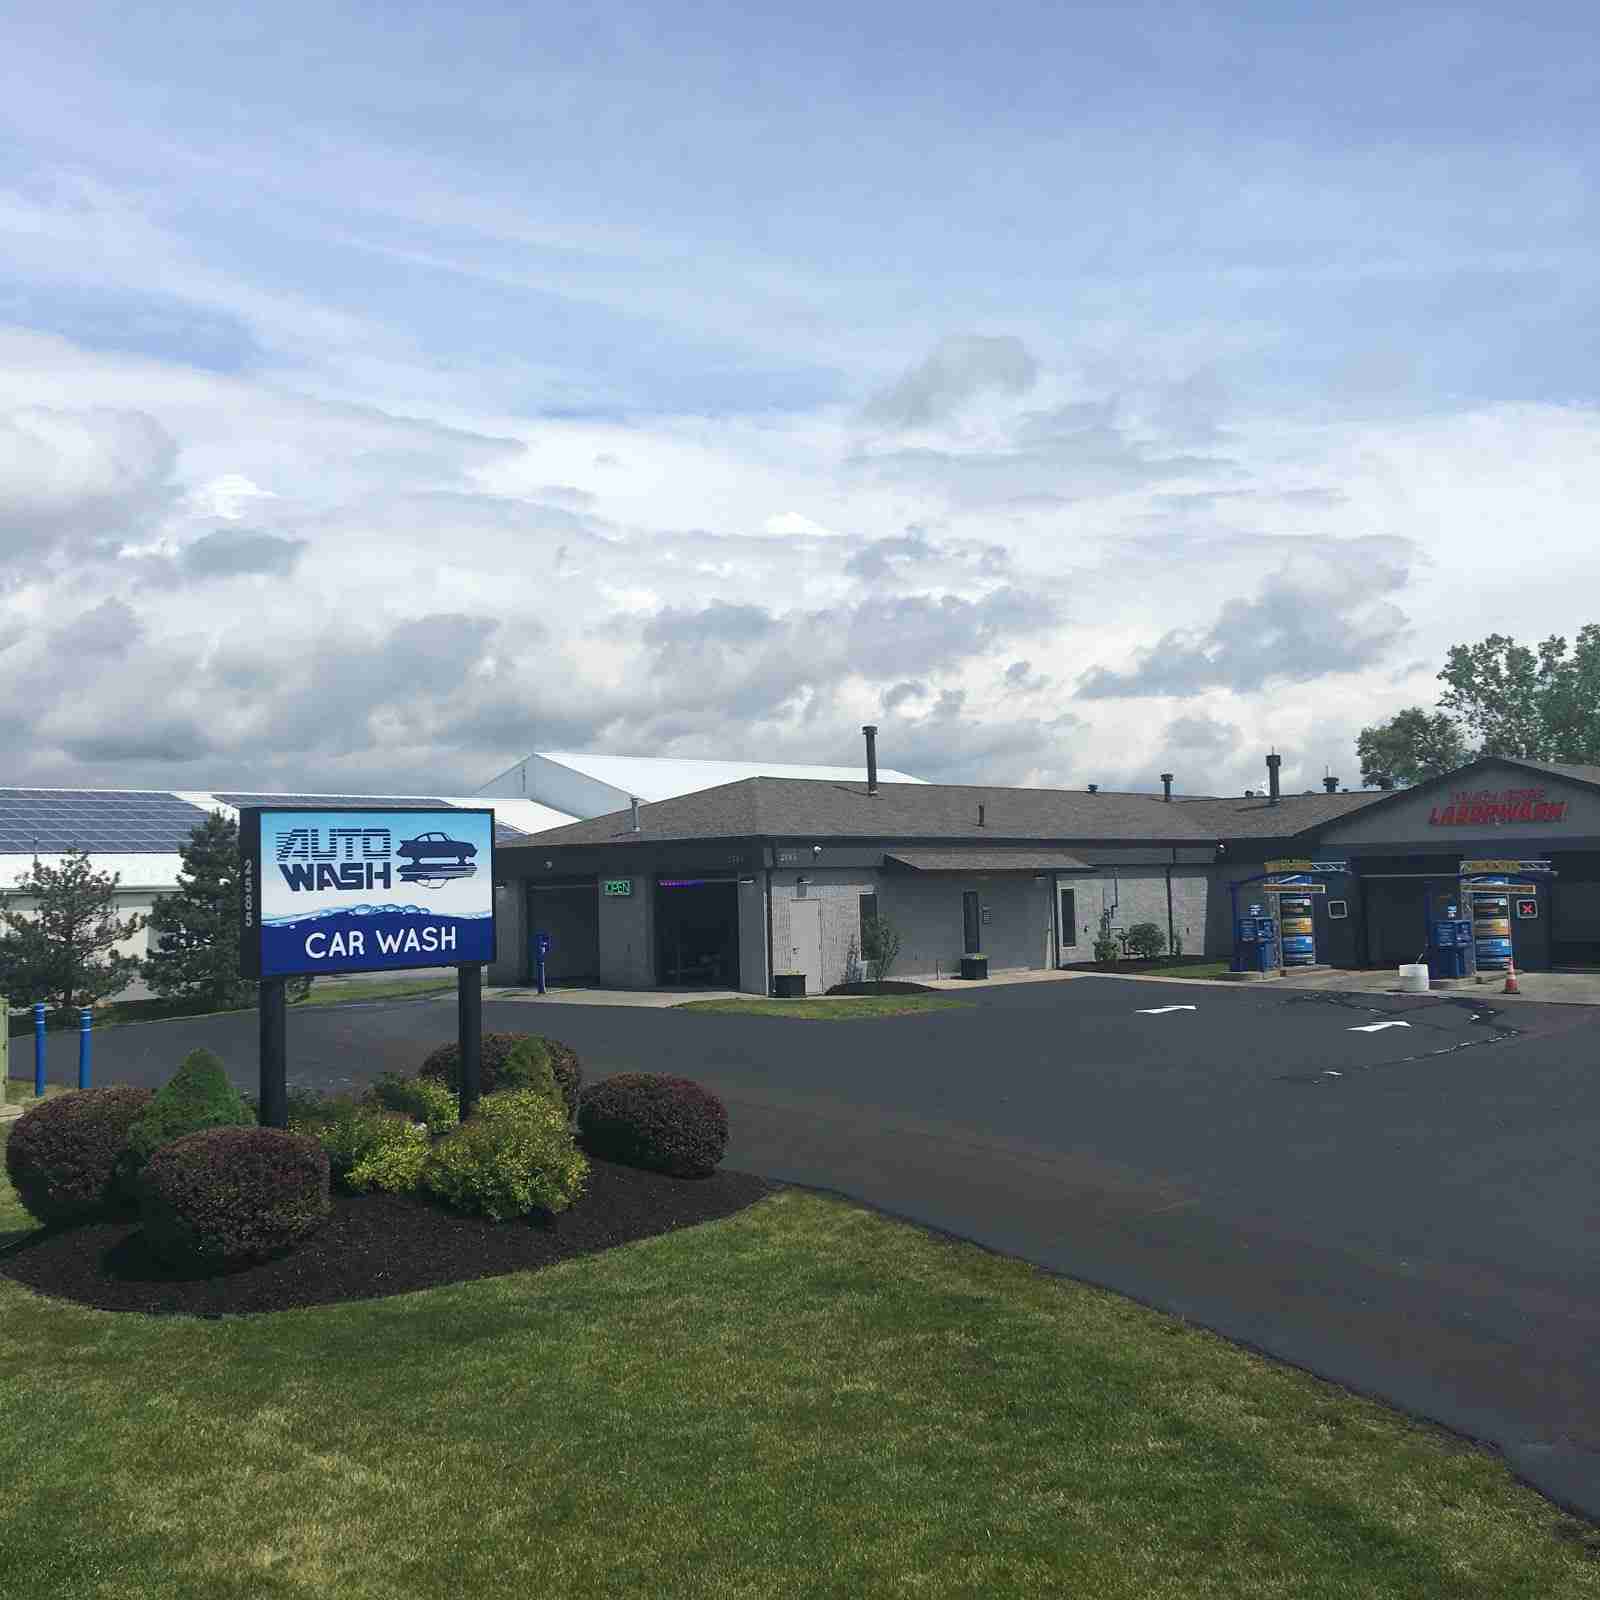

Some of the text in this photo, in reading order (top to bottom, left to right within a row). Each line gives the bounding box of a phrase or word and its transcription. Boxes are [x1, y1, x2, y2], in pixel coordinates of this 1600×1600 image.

[276, 828, 391, 861] AUTO
[278, 862, 391, 891] WASH
[606, 881, 630, 894] OPEN
[305, 926, 456, 958] CAR WASH
